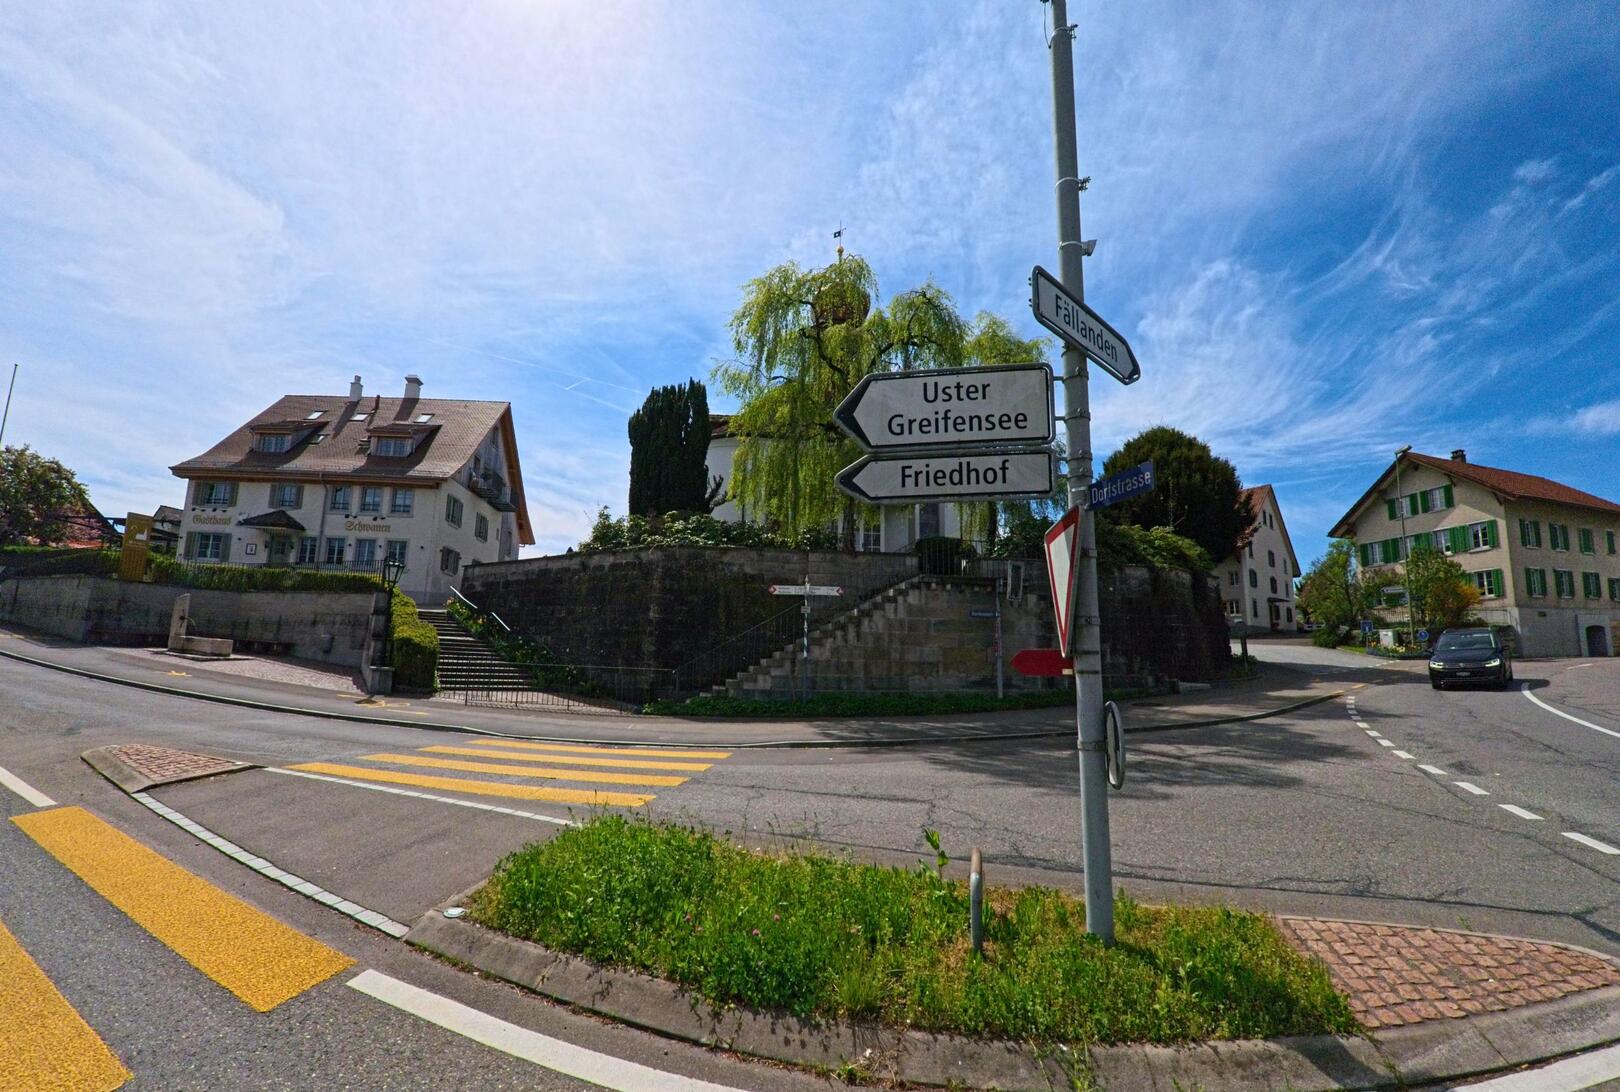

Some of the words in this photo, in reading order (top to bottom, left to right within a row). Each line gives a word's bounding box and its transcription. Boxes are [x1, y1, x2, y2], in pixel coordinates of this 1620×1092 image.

[1055, 293, 1118, 362] Fällanden
[923, 381, 990, 403] Uster
[887, 409, 1028, 436] Greifensee
[901, 459, 1009, 488] Friedhof
[1091, 471, 1151, 504] Dorfstrasse
